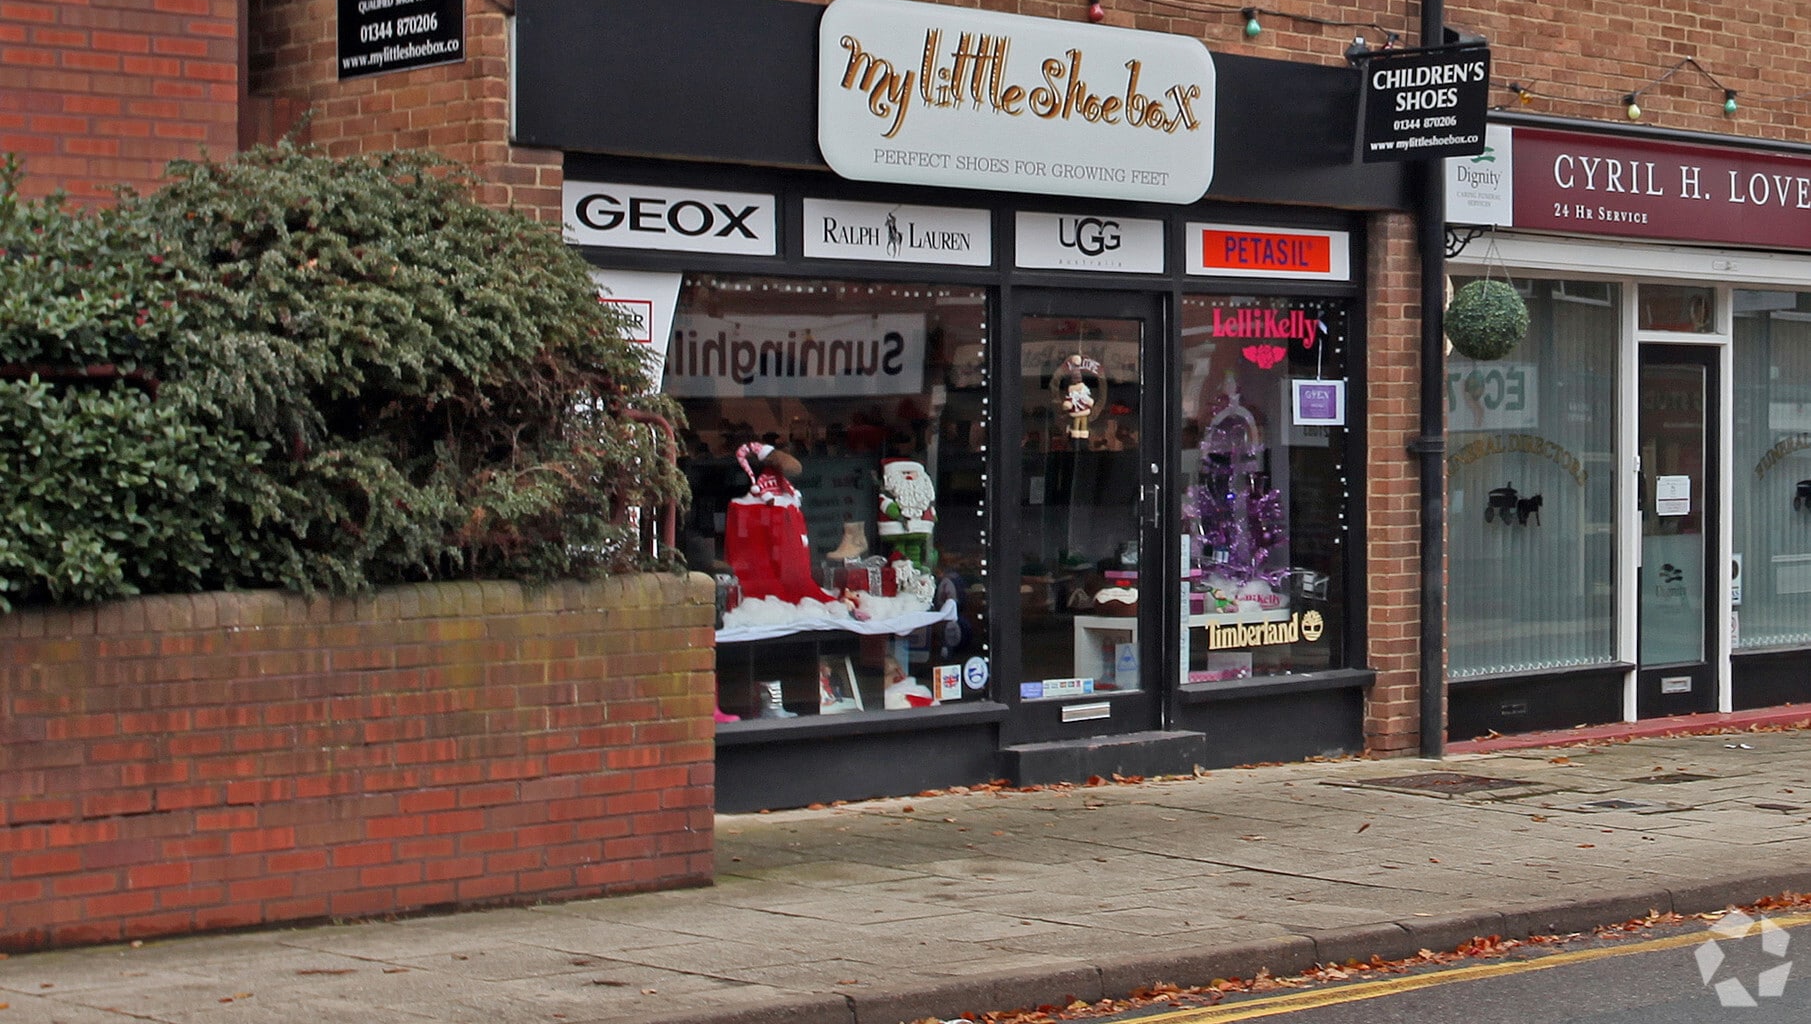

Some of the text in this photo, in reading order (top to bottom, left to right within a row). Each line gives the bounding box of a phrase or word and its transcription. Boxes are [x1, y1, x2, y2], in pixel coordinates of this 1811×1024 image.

[360, 12, 438, 43] 01344 870206
[342, 39, 459, 69] www.mylittleshoebox.co
[1373, 61, 1485, 90] CHILDREN'S
[1395, 88, 1458, 112] SHOES
[1393, 115, 1457, 131] 01344 870206
[873, 148, 1169, 186] PERFECT SHOES FOR GROWING FEET
[1457, 165, 1501, 191] Dignity
[1553, 154, 1811, 209] CYRIL H. LOVE
[575, 193, 760, 240] GEOX
[1554, 203, 1570, 218] 24
[822, 216, 971, 252] RALPH LAUREN
[1059, 217, 1121, 256] UGG
[1224, 235, 1310, 267] PETASIL
[1204, 612, 1299, 650] Timberland
